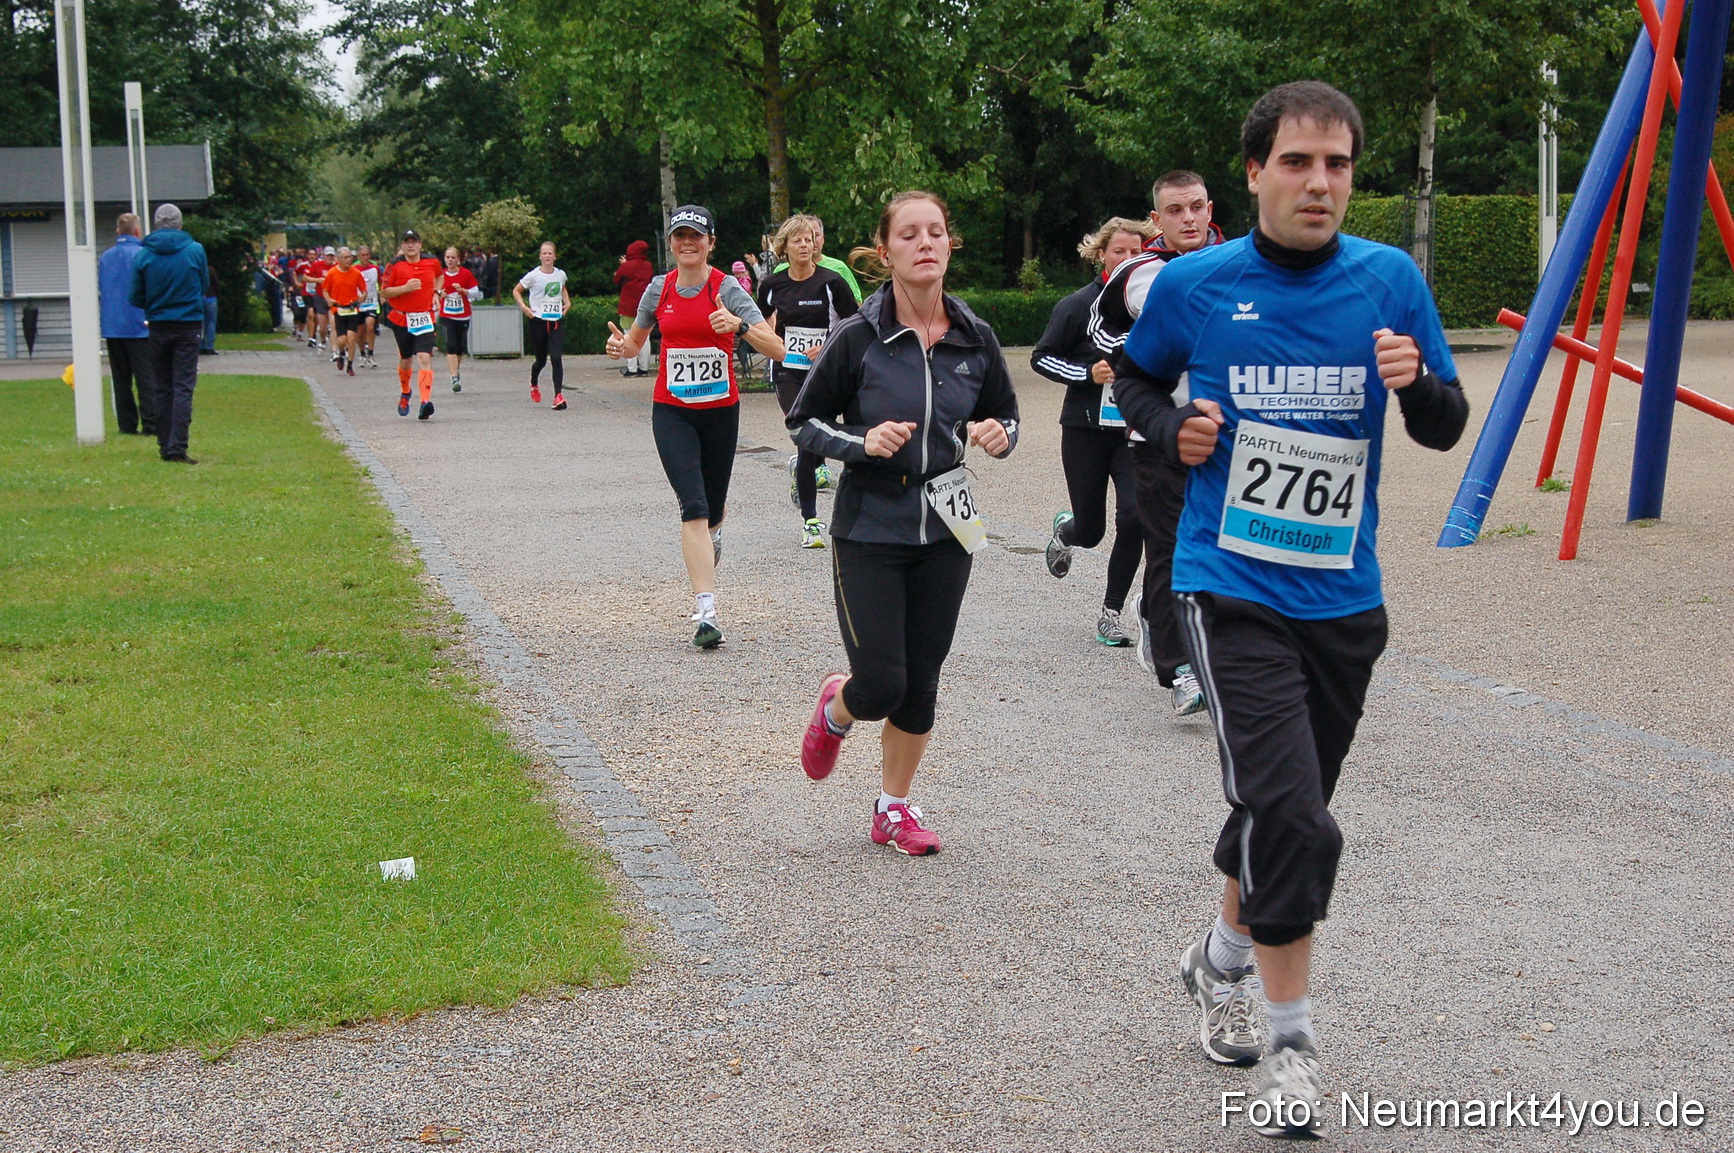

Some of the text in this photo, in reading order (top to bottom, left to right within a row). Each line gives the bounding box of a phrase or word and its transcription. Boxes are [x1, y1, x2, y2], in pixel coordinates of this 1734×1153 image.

[671, 211, 707, 225] adidas
[446, 299, 462, 307] 2319
[543, 304, 560, 313] 2743
[409, 315, 430, 327] 2189
[1232, 312, 1260, 321] erima
[673, 360, 723, 383] 2128
[1228, 365, 1367, 394] HUBER
[684, 387, 713, 396] Marion
[1258, 397, 1361, 408] TECHNOLOGY
[1258, 411, 1291, 420] WASTE
[1292, 411, 1325, 420] WATER
[1238, 433, 1353, 466] PARTL Neumarkt
[1241, 457, 1356, 519] 2764
[1249, 519, 1333, 552] Christoph
